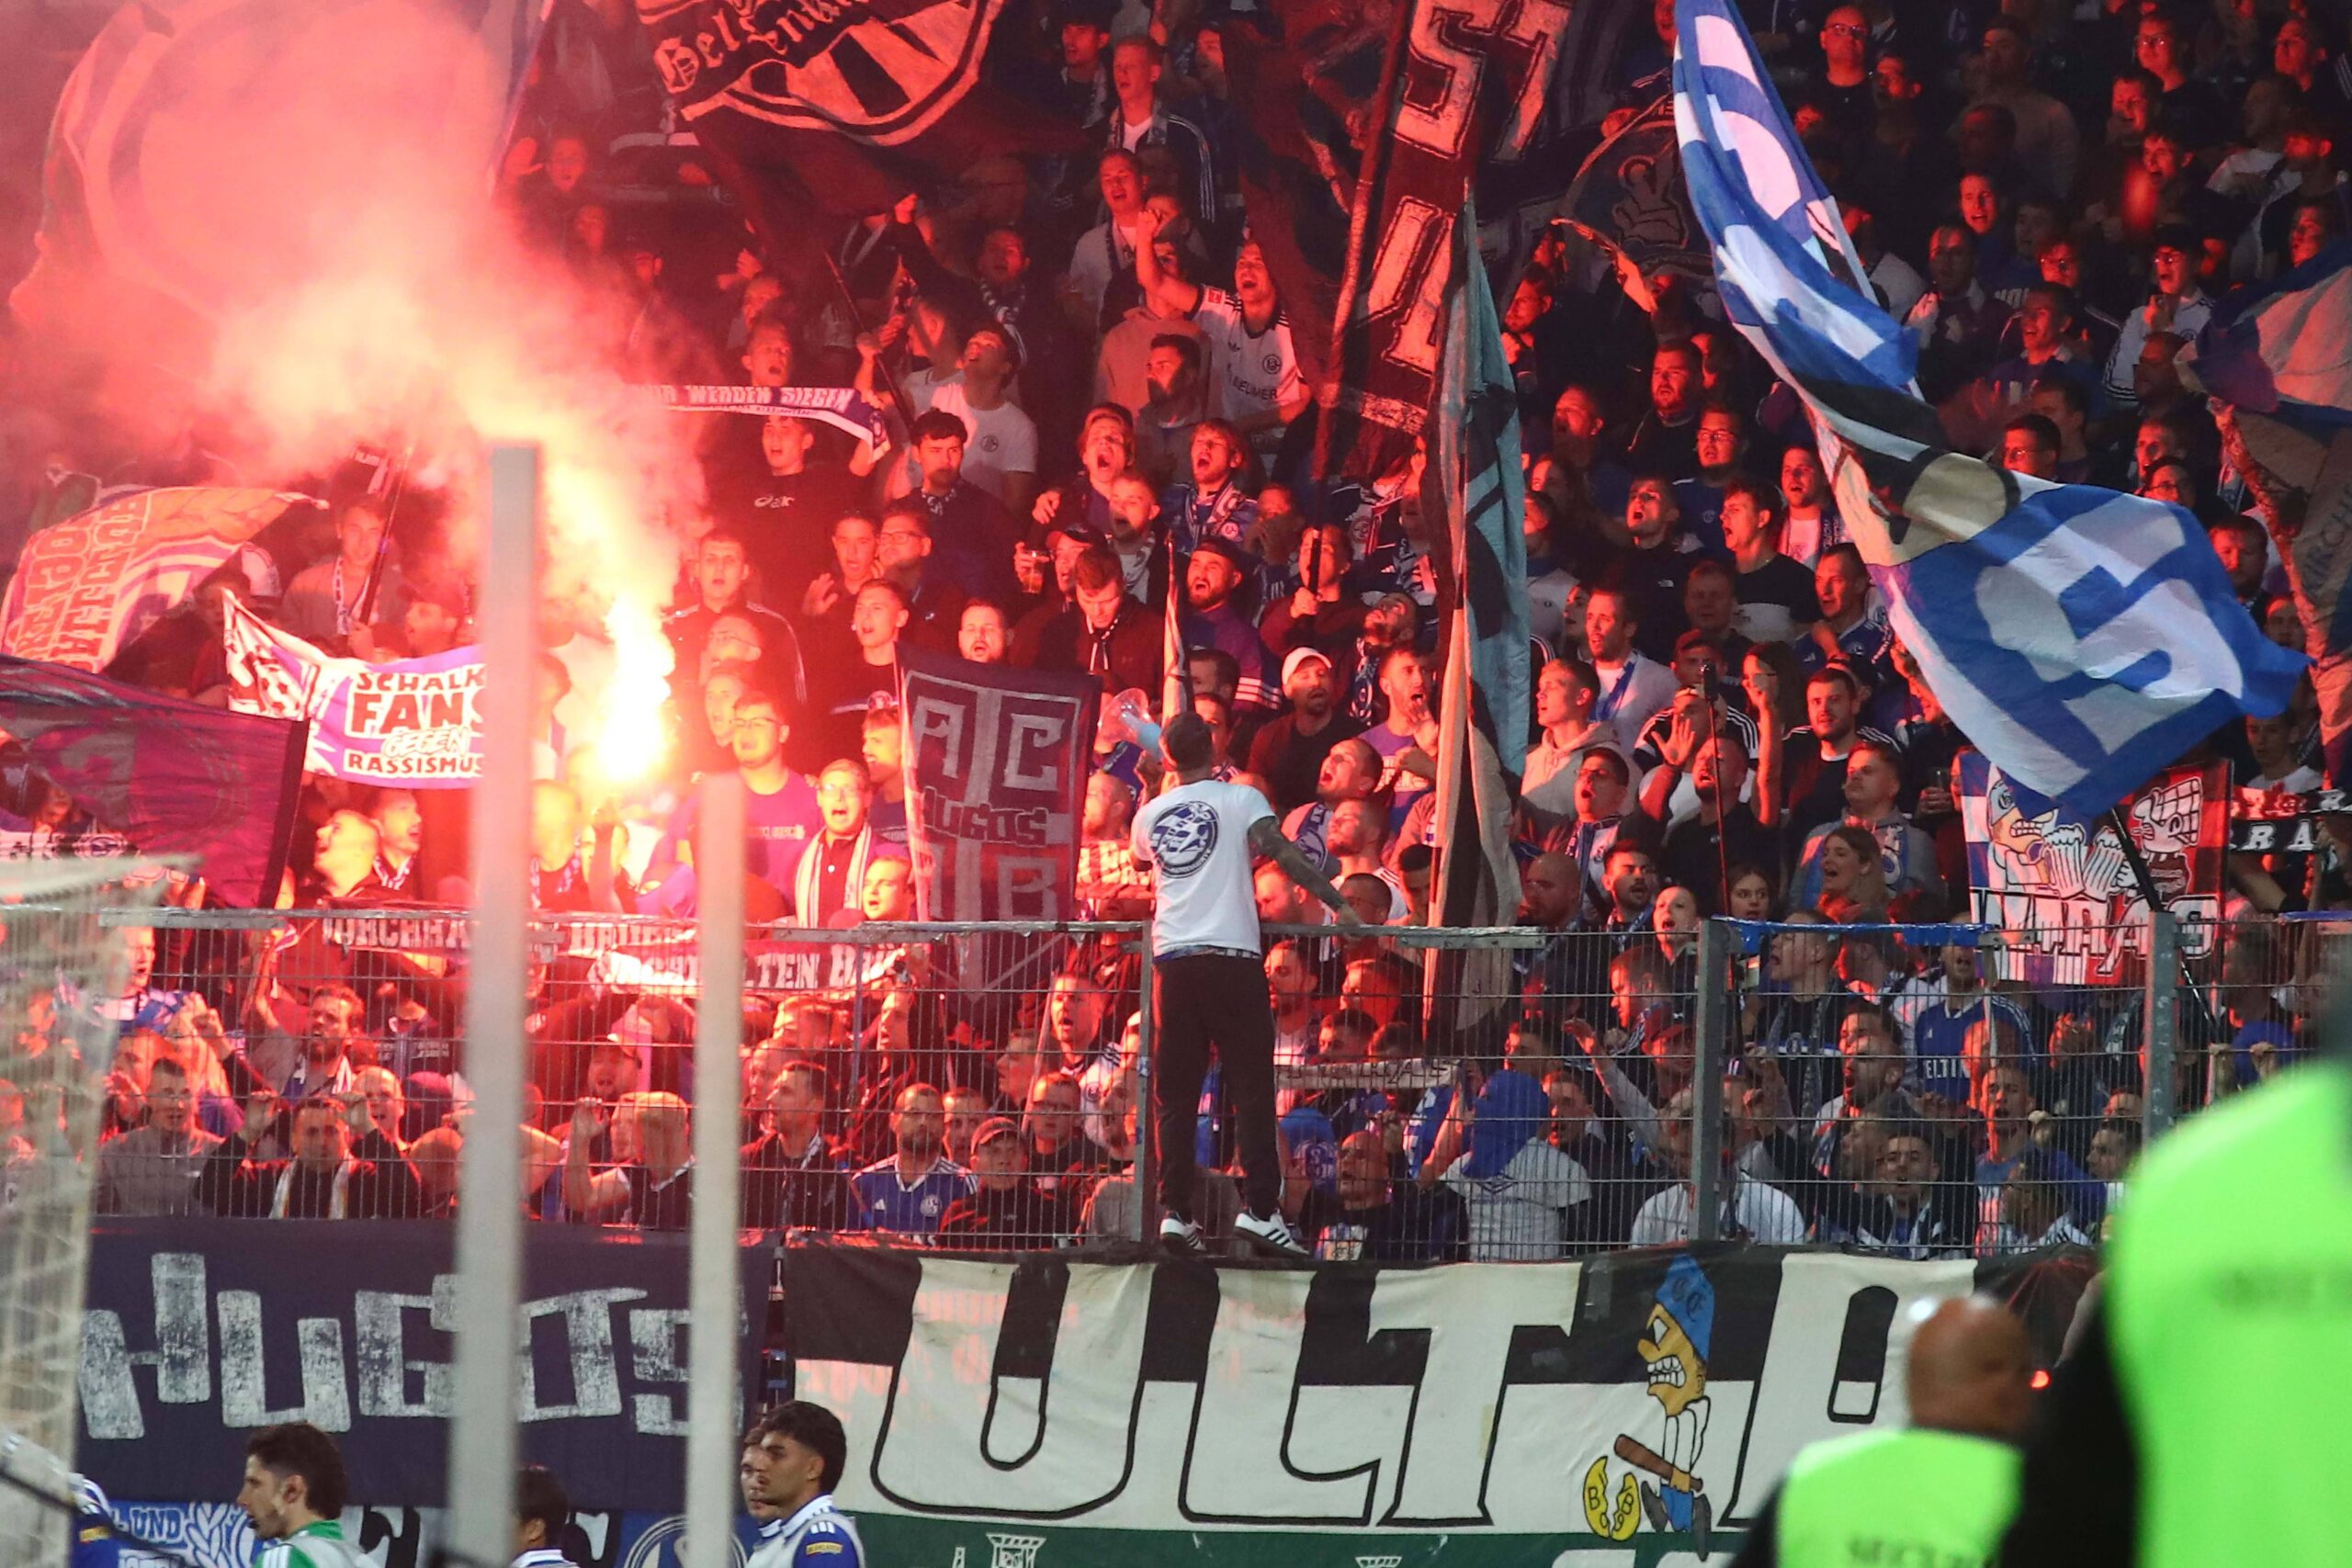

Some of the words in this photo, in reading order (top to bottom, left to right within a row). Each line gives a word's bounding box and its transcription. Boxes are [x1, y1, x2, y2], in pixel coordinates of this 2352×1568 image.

[686, 385, 773, 404] WERDEN
[780, 387, 854, 412] SIEGEN
[356, 668, 486, 692] SCHALK
[381, 727, 471, 759] GEGEN
